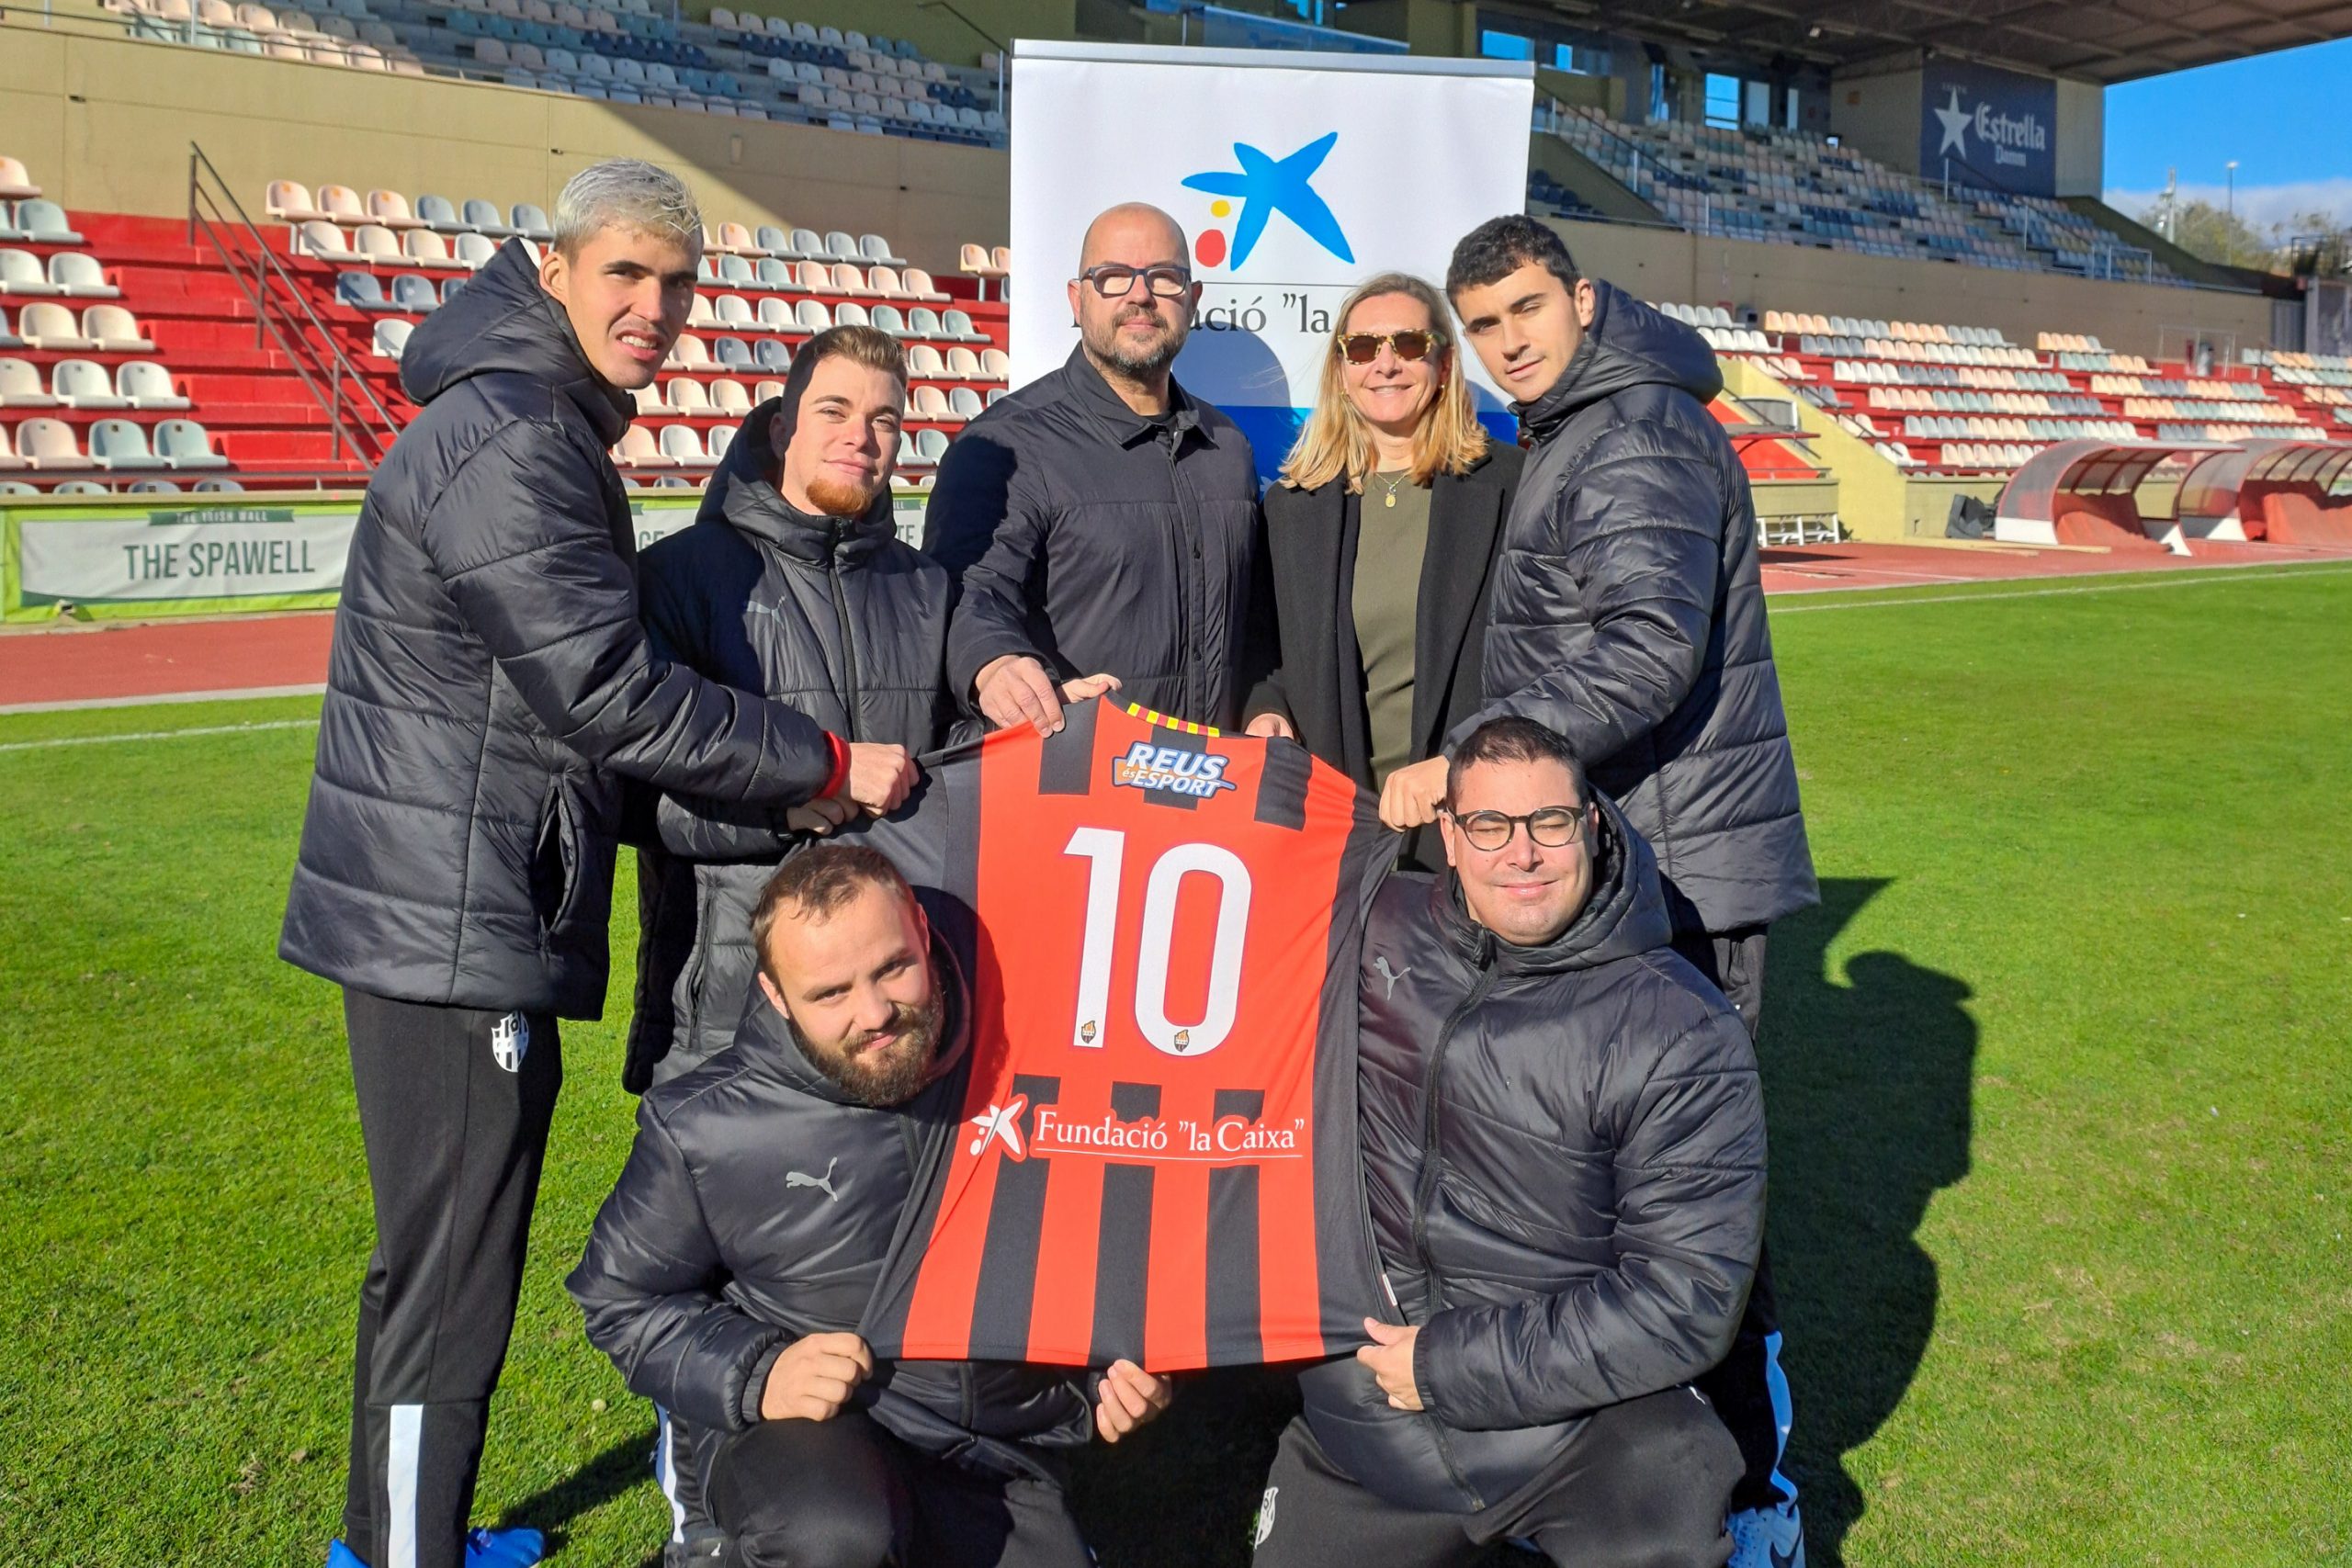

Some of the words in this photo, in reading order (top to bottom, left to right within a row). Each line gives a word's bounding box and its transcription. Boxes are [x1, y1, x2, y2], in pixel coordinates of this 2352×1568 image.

[1975, 102, 2046, 152] Estrella
[1191, 296, 1267, 332] ació
[238, 510, 267, 523] WALL
[123, 544, 180, 581] THE
[188, 540, 315, 577] SPAWELL
[1126, 744, 1228, 780] REUS
[1122, 768, 1136, 779] és
[1132, 770, 1221, 795] ESPORT
[1063, 827, 1252, 1056] 10
[1036, 1111, 1168, 1150] Fundació
